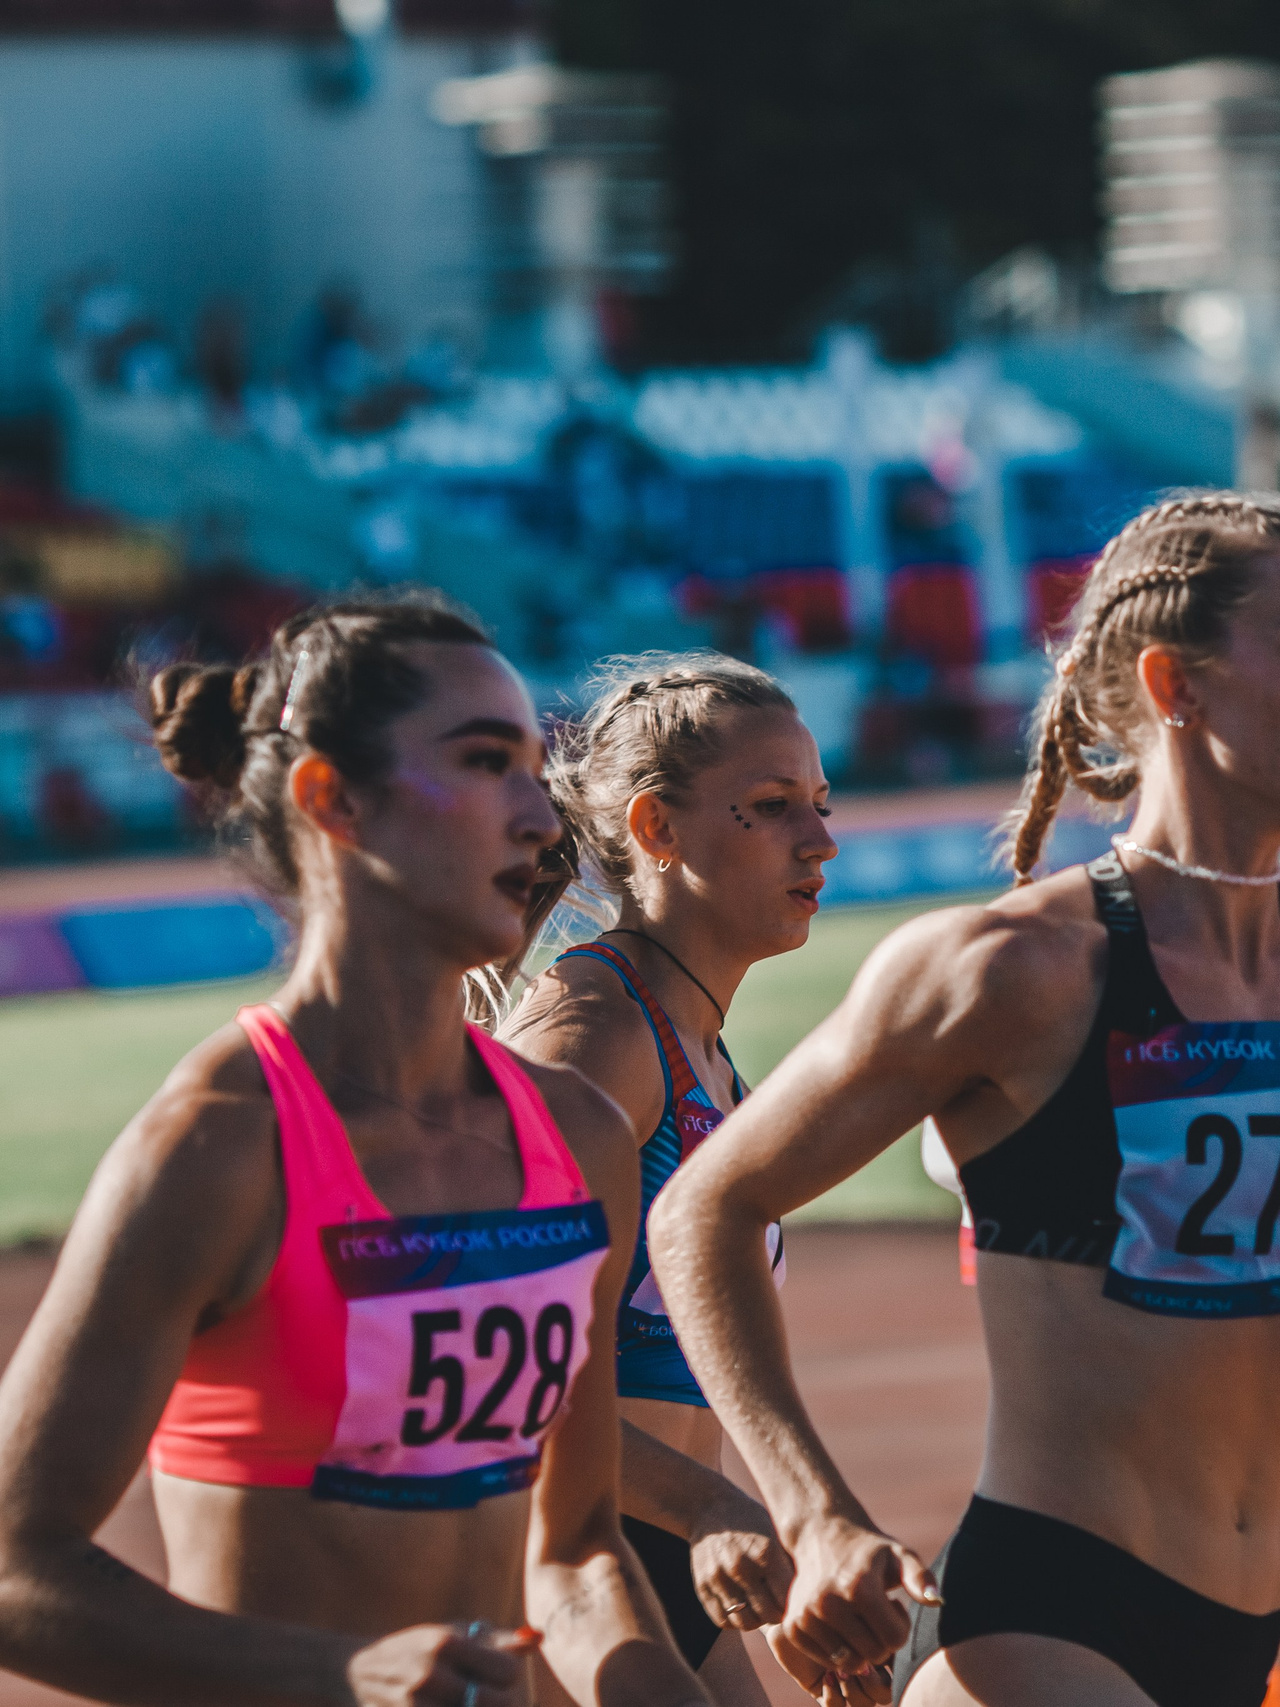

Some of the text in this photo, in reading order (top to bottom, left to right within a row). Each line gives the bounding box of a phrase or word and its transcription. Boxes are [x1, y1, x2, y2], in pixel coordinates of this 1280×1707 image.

[1186, 1039, 1276, 1061] КУБОК
[401, 1228, 495, 1255] КУБОК
[497, 1217, 592, 1250] РОССИИ
[402, 1302, 573, 1446] 528
